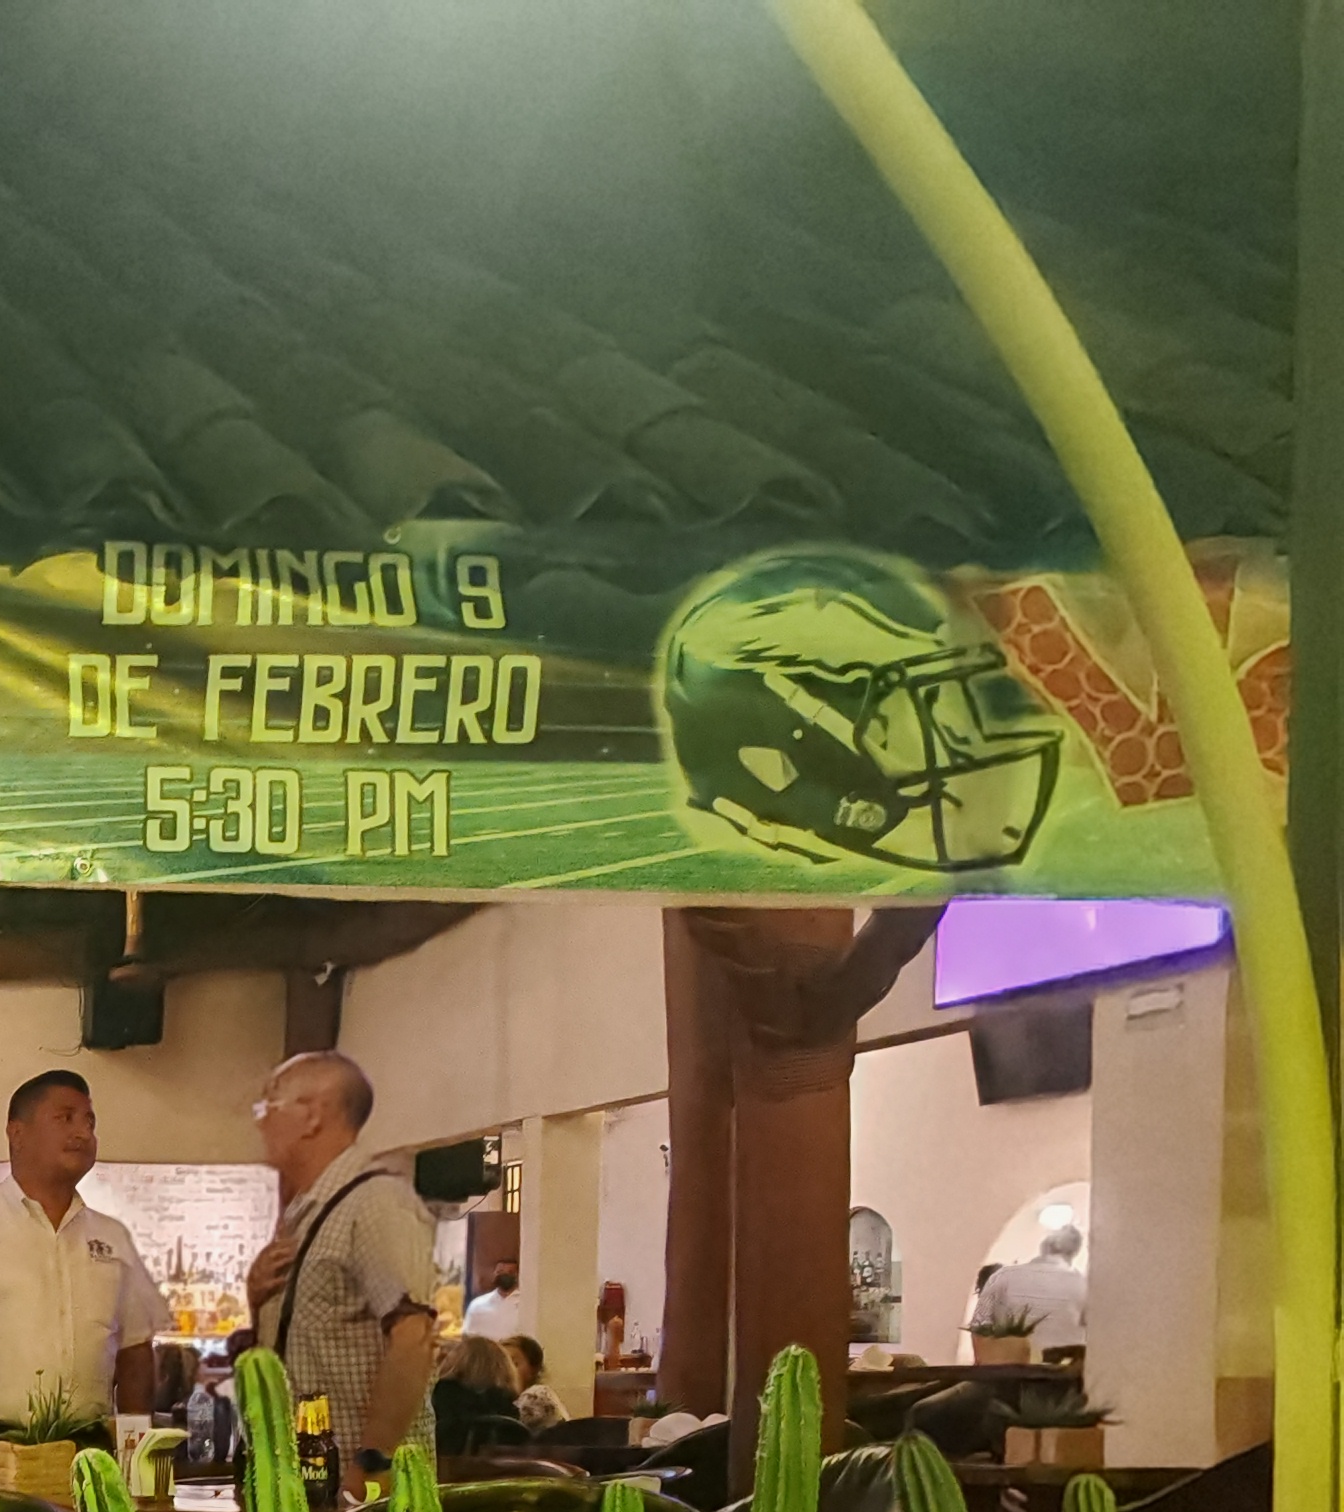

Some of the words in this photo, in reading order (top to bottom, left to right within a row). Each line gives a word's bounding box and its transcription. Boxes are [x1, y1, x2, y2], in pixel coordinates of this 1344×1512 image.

[100, 538, 418, 627] DOMINGO
[454, 553, 507, 630] 9
[67, 653, 160, 738] DE
[203, 653, 543, 745] FEBRERO
[144, 766, 302, 855] 5:30
[344, 769, 452, 858] PM
